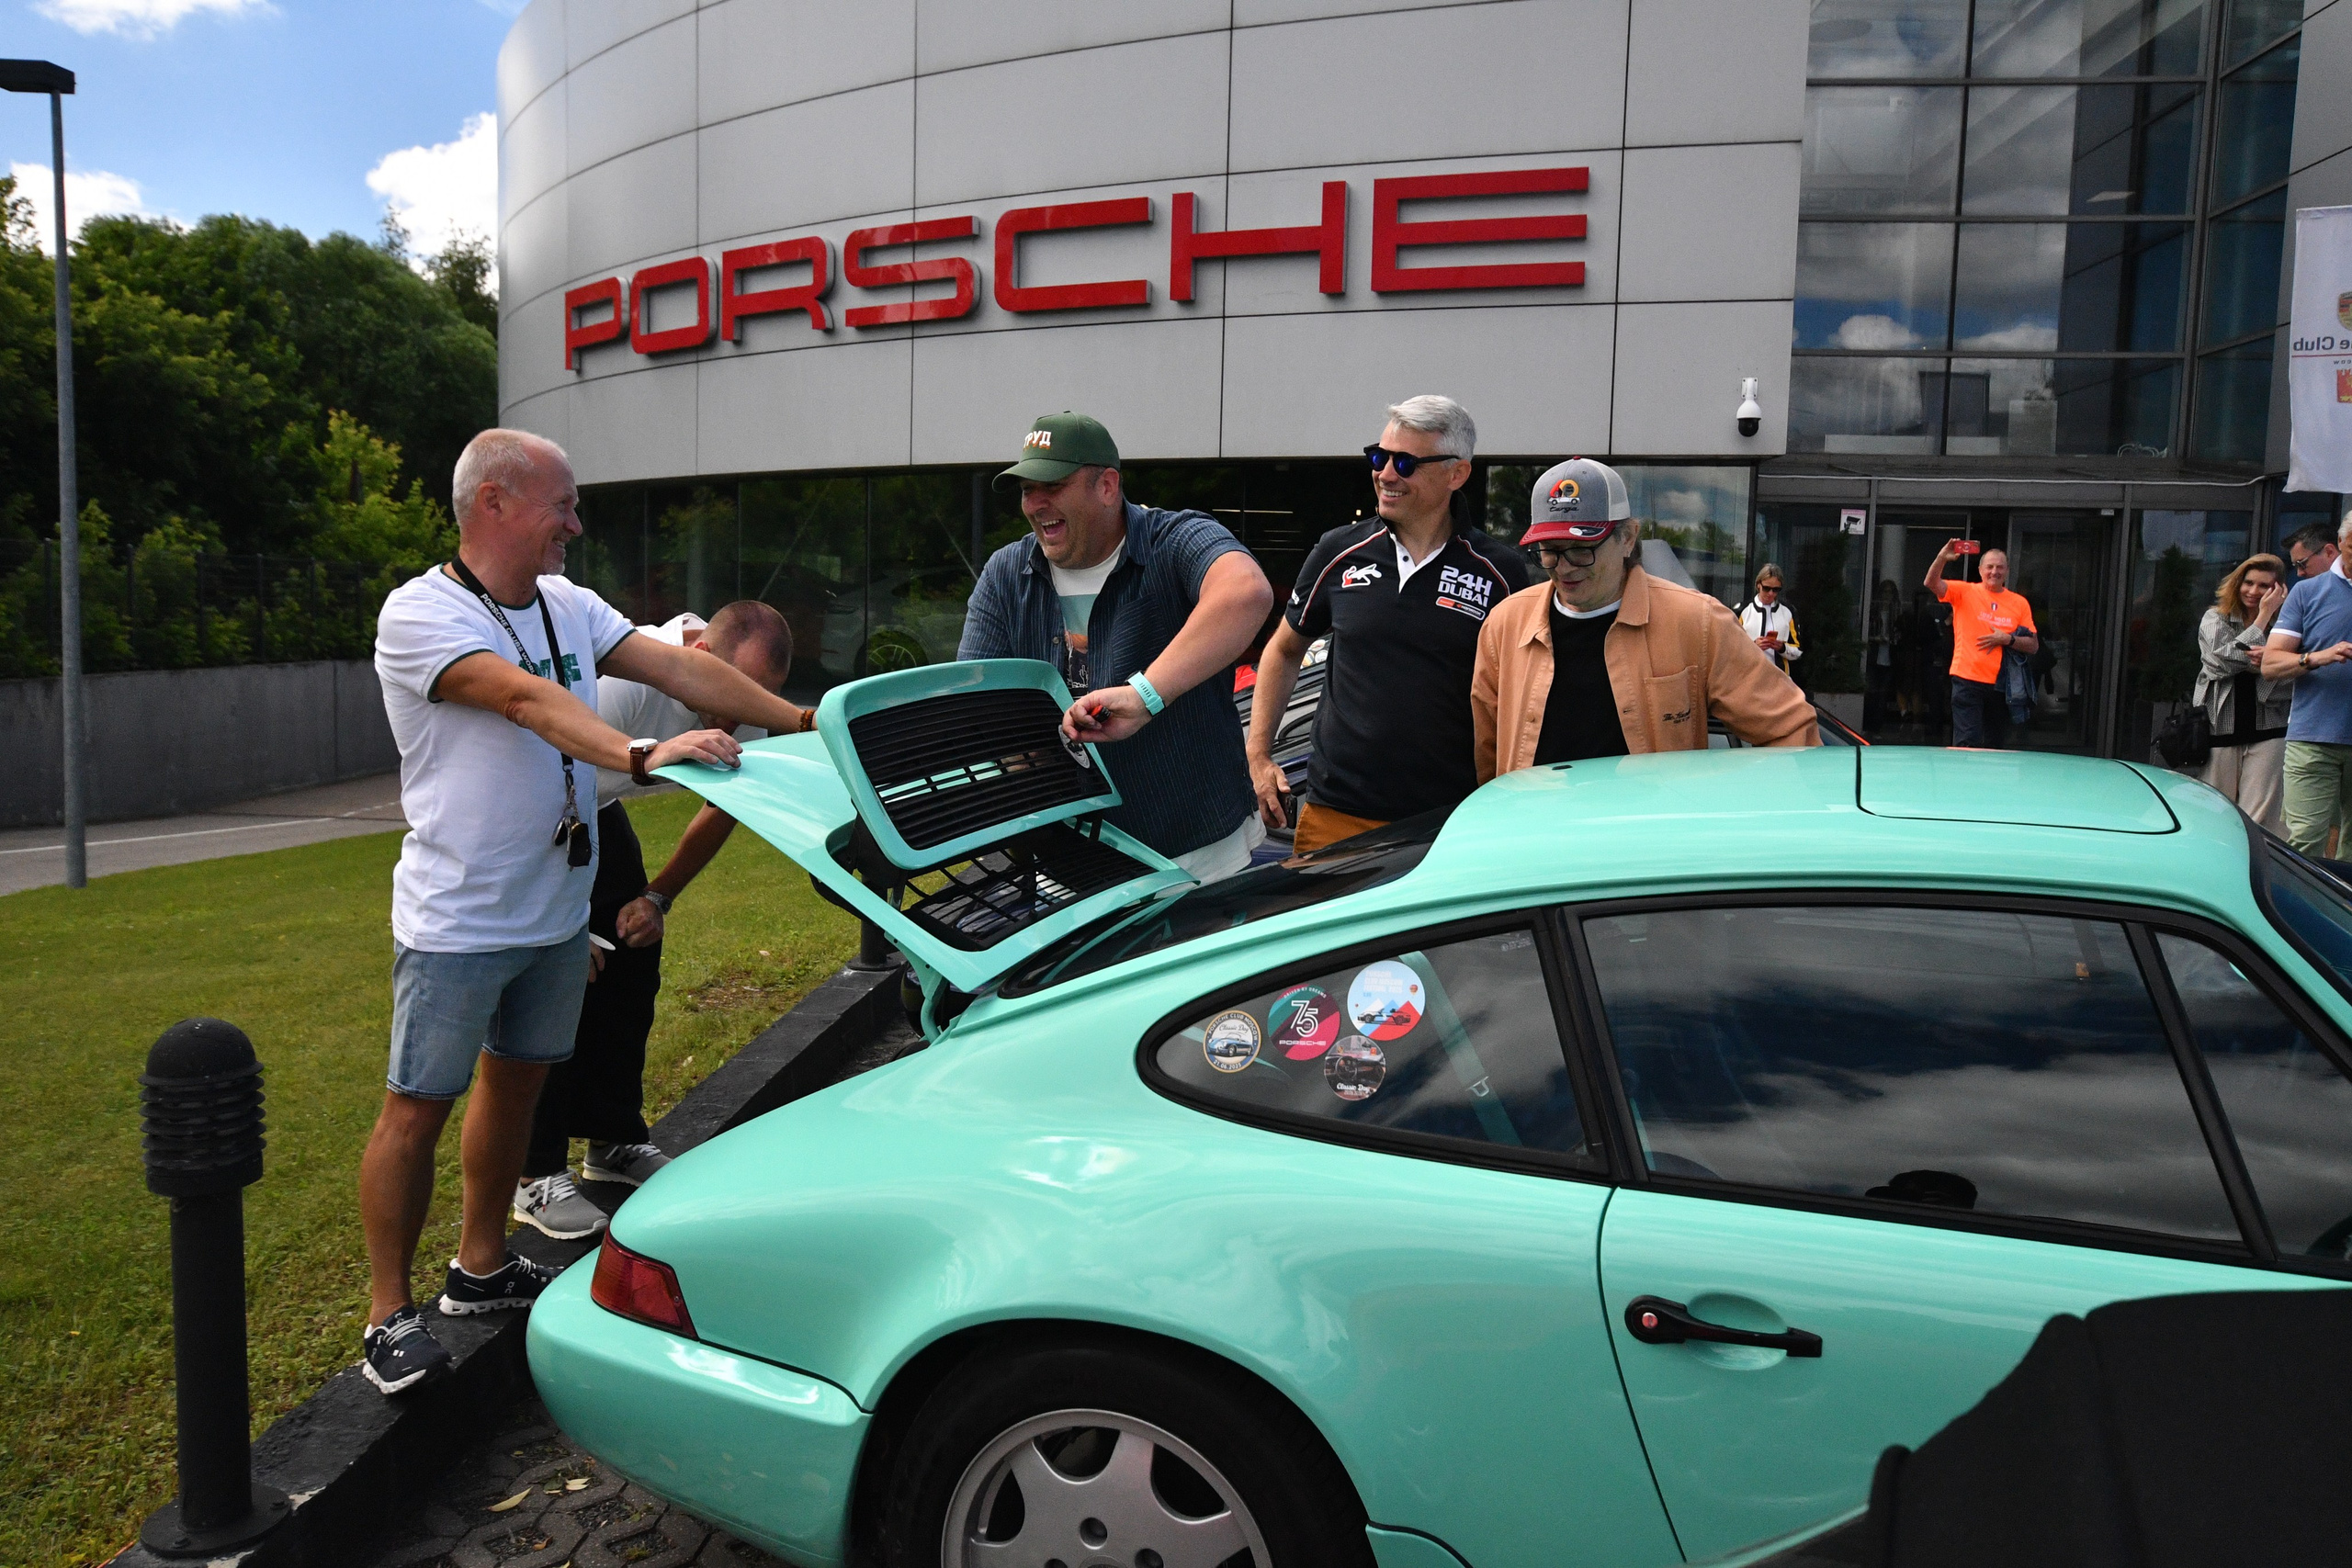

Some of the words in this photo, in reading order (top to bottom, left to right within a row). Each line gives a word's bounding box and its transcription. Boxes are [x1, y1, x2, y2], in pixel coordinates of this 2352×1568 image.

[564, 166, 1589, 371] PORSCHE
[1437, 581, 1488, 608] DUBAI
[1440, 565, 1493, 597] 24H
[480, 592, 509, 627] PORSCHE
[506, 626, 524, 653] CLUBS
[521, 651, 536, 675] WORL
[1208, 1014, 1229, 1034] PORSCHE
[1244, 1017, 1259, 1041] MOSCOW
[1290, 999, 1319, 1038] 75
